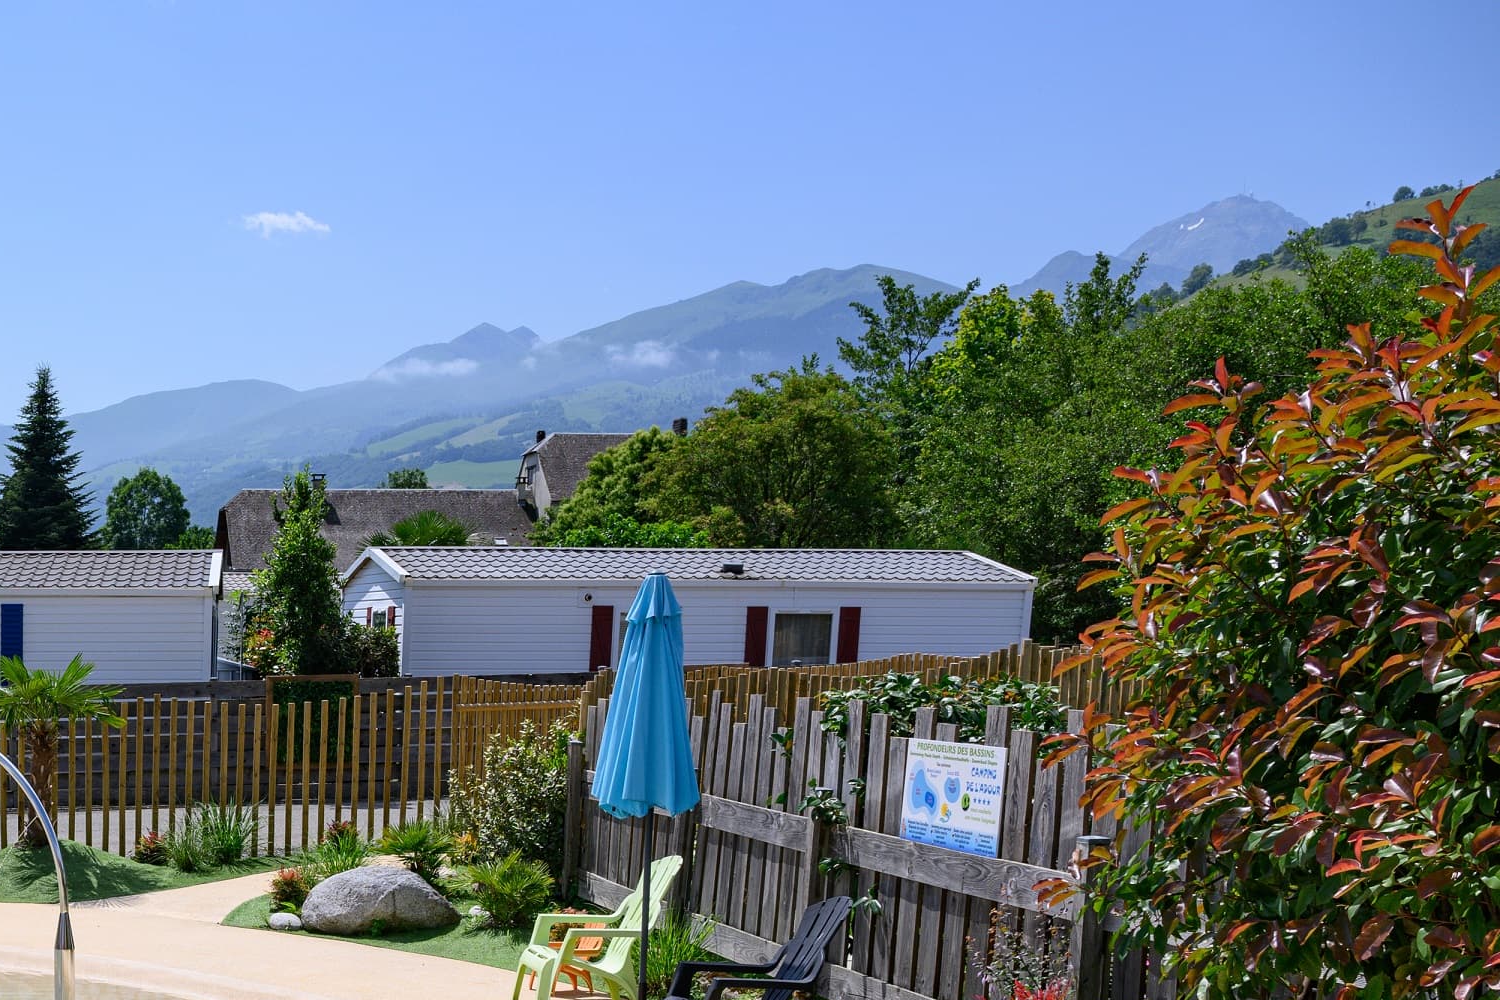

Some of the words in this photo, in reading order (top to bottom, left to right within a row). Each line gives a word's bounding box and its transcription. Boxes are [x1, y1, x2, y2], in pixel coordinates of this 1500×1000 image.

[917, 742, 956, 754] PROFONDEURS
[957, 746, 968, 755] DES
[969, 747, 994, 758] BASSINS
[971, 767, 996, 779] CAMPING
[966, 781, 973, 792] DE
